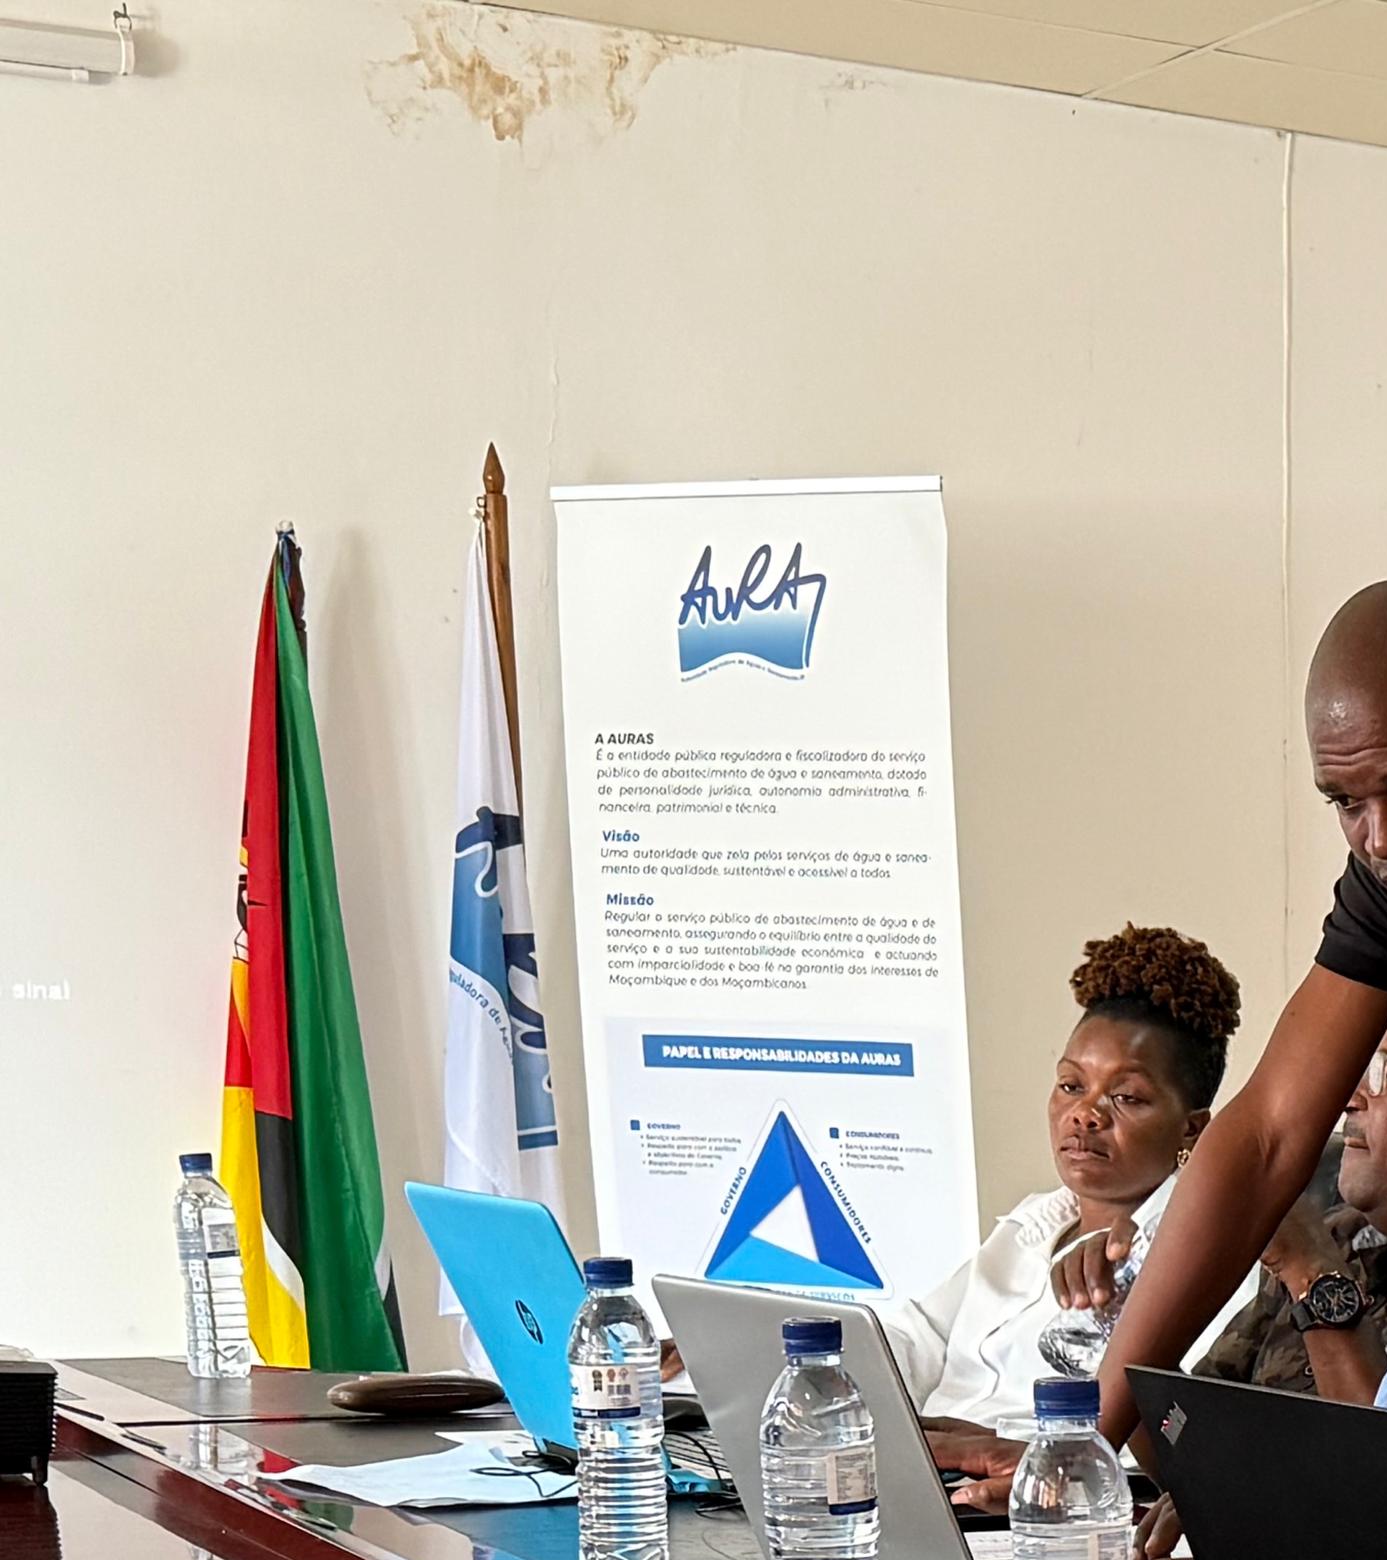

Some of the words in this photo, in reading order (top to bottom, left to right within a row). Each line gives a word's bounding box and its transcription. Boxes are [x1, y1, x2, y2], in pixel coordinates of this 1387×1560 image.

[662, 1045, 701, 1059] PAPEL
[703, 1047, 712, 1059] E
[713, 1048, 840, 1065] RESPONSABILIDADES
[841, 1051, 859, 1065] DA
[861, 1052, 901, 1066] AURAS
[720, 1166, 748, 1216] GOVERNO
[820, 1160, 872, 1244] CONSUMIDORES
